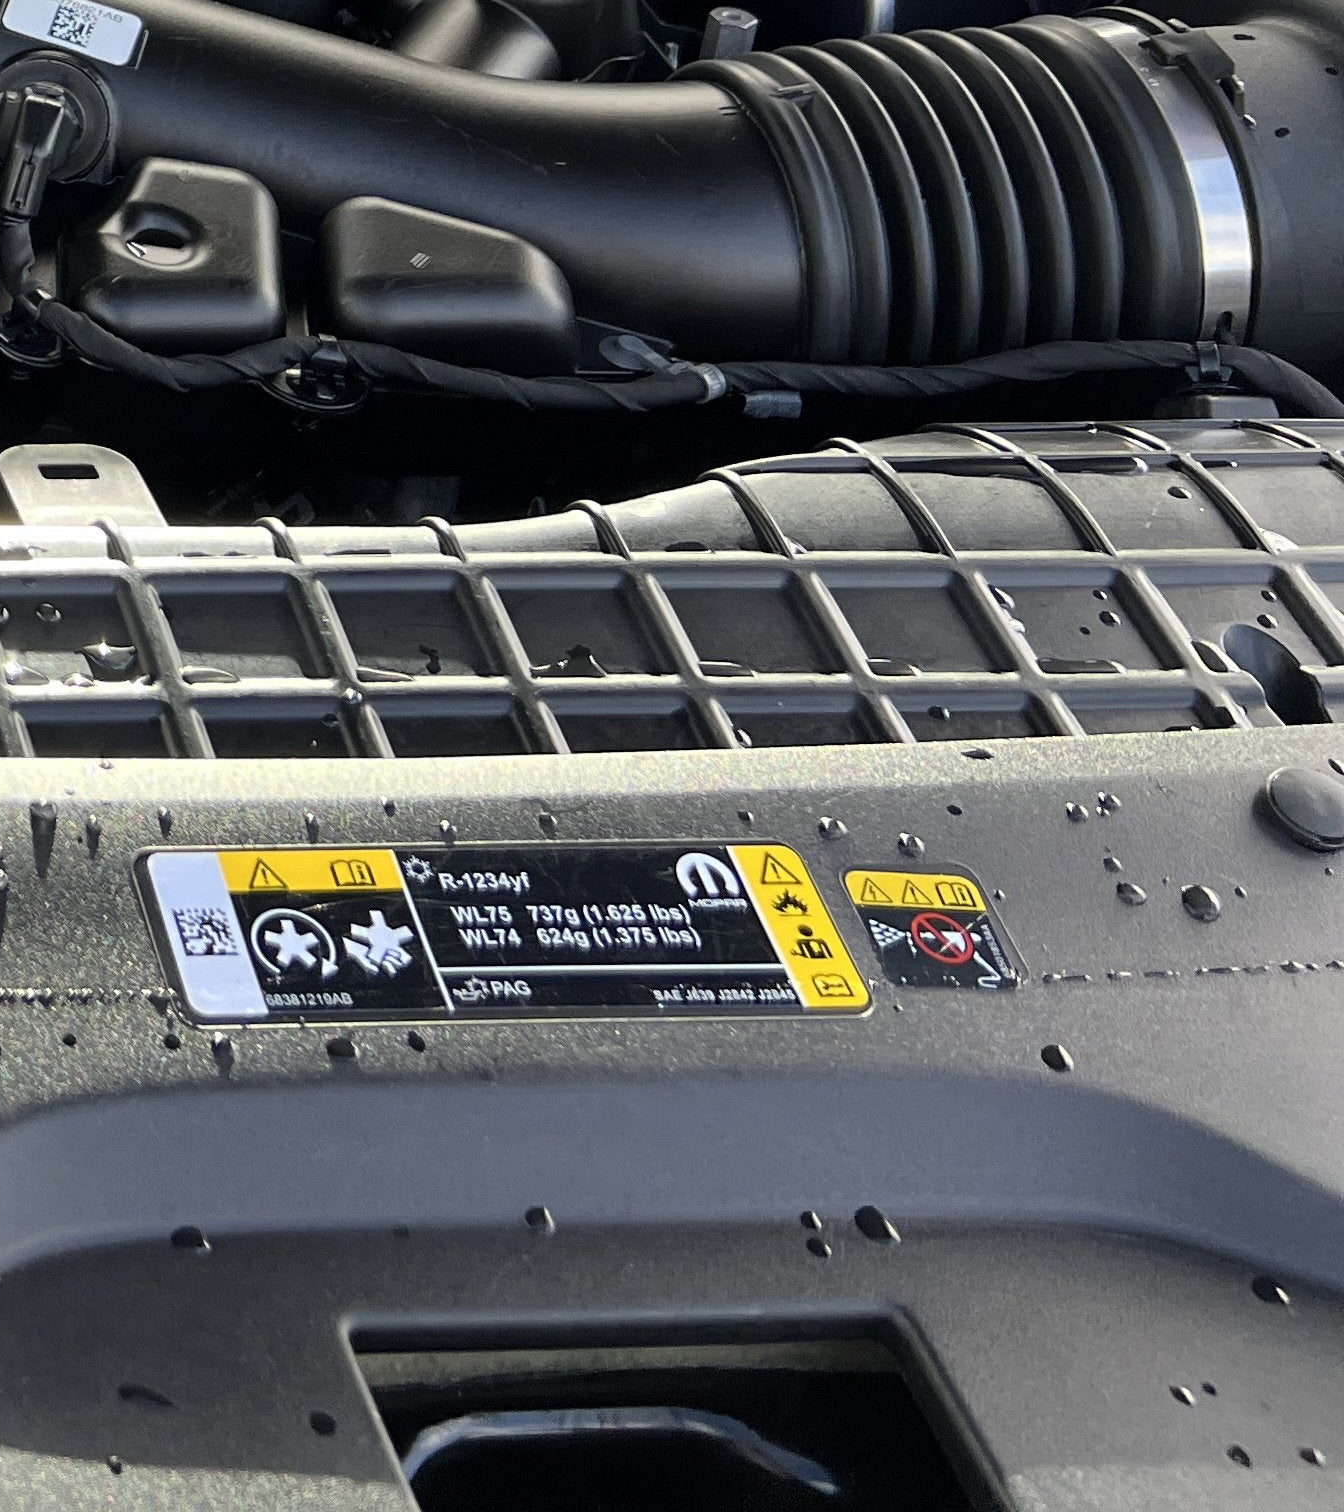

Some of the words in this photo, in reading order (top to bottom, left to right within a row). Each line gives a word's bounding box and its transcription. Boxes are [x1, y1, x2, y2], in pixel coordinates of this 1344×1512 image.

[438, 871, 531, 893] R-1234yf
[688, 898, 748, 908] MOPAR
[450, 905, 512, 925] WL75
[525, 905, 581, 926] 737g
[583, 904, 646, 926] (1.625
[650, 903, 692, 926] lbs)
[458, 928, 522, 948] WL74
[536, 928, 591, 951] 624g
[592, 927, 656, 949] (1.375
[660, 926, 702, 951] lbs)
[490, 980, 532, 998] PAG
